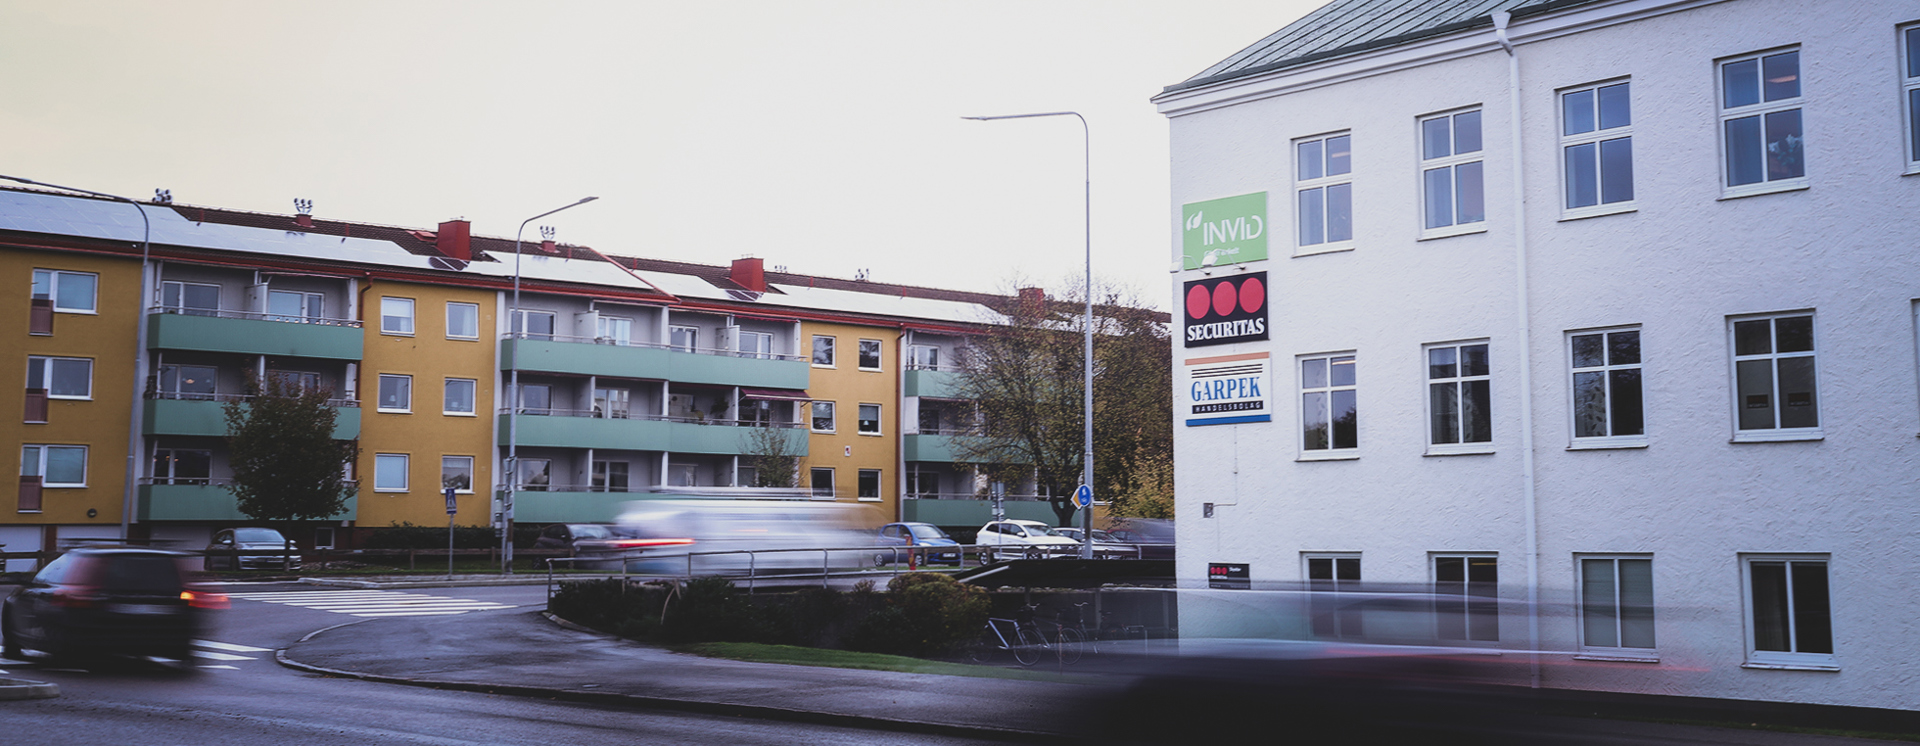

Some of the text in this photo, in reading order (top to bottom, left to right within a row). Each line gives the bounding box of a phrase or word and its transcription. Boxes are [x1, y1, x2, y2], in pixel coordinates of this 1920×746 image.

[1203, 214, 1264, 246] INVID
[1187, 317, 1265, 341] SECURITAS
[1191, 376, 1261, 402] GARPEK
[1195, 401, 1261, 412] HANDELSBOLAG
